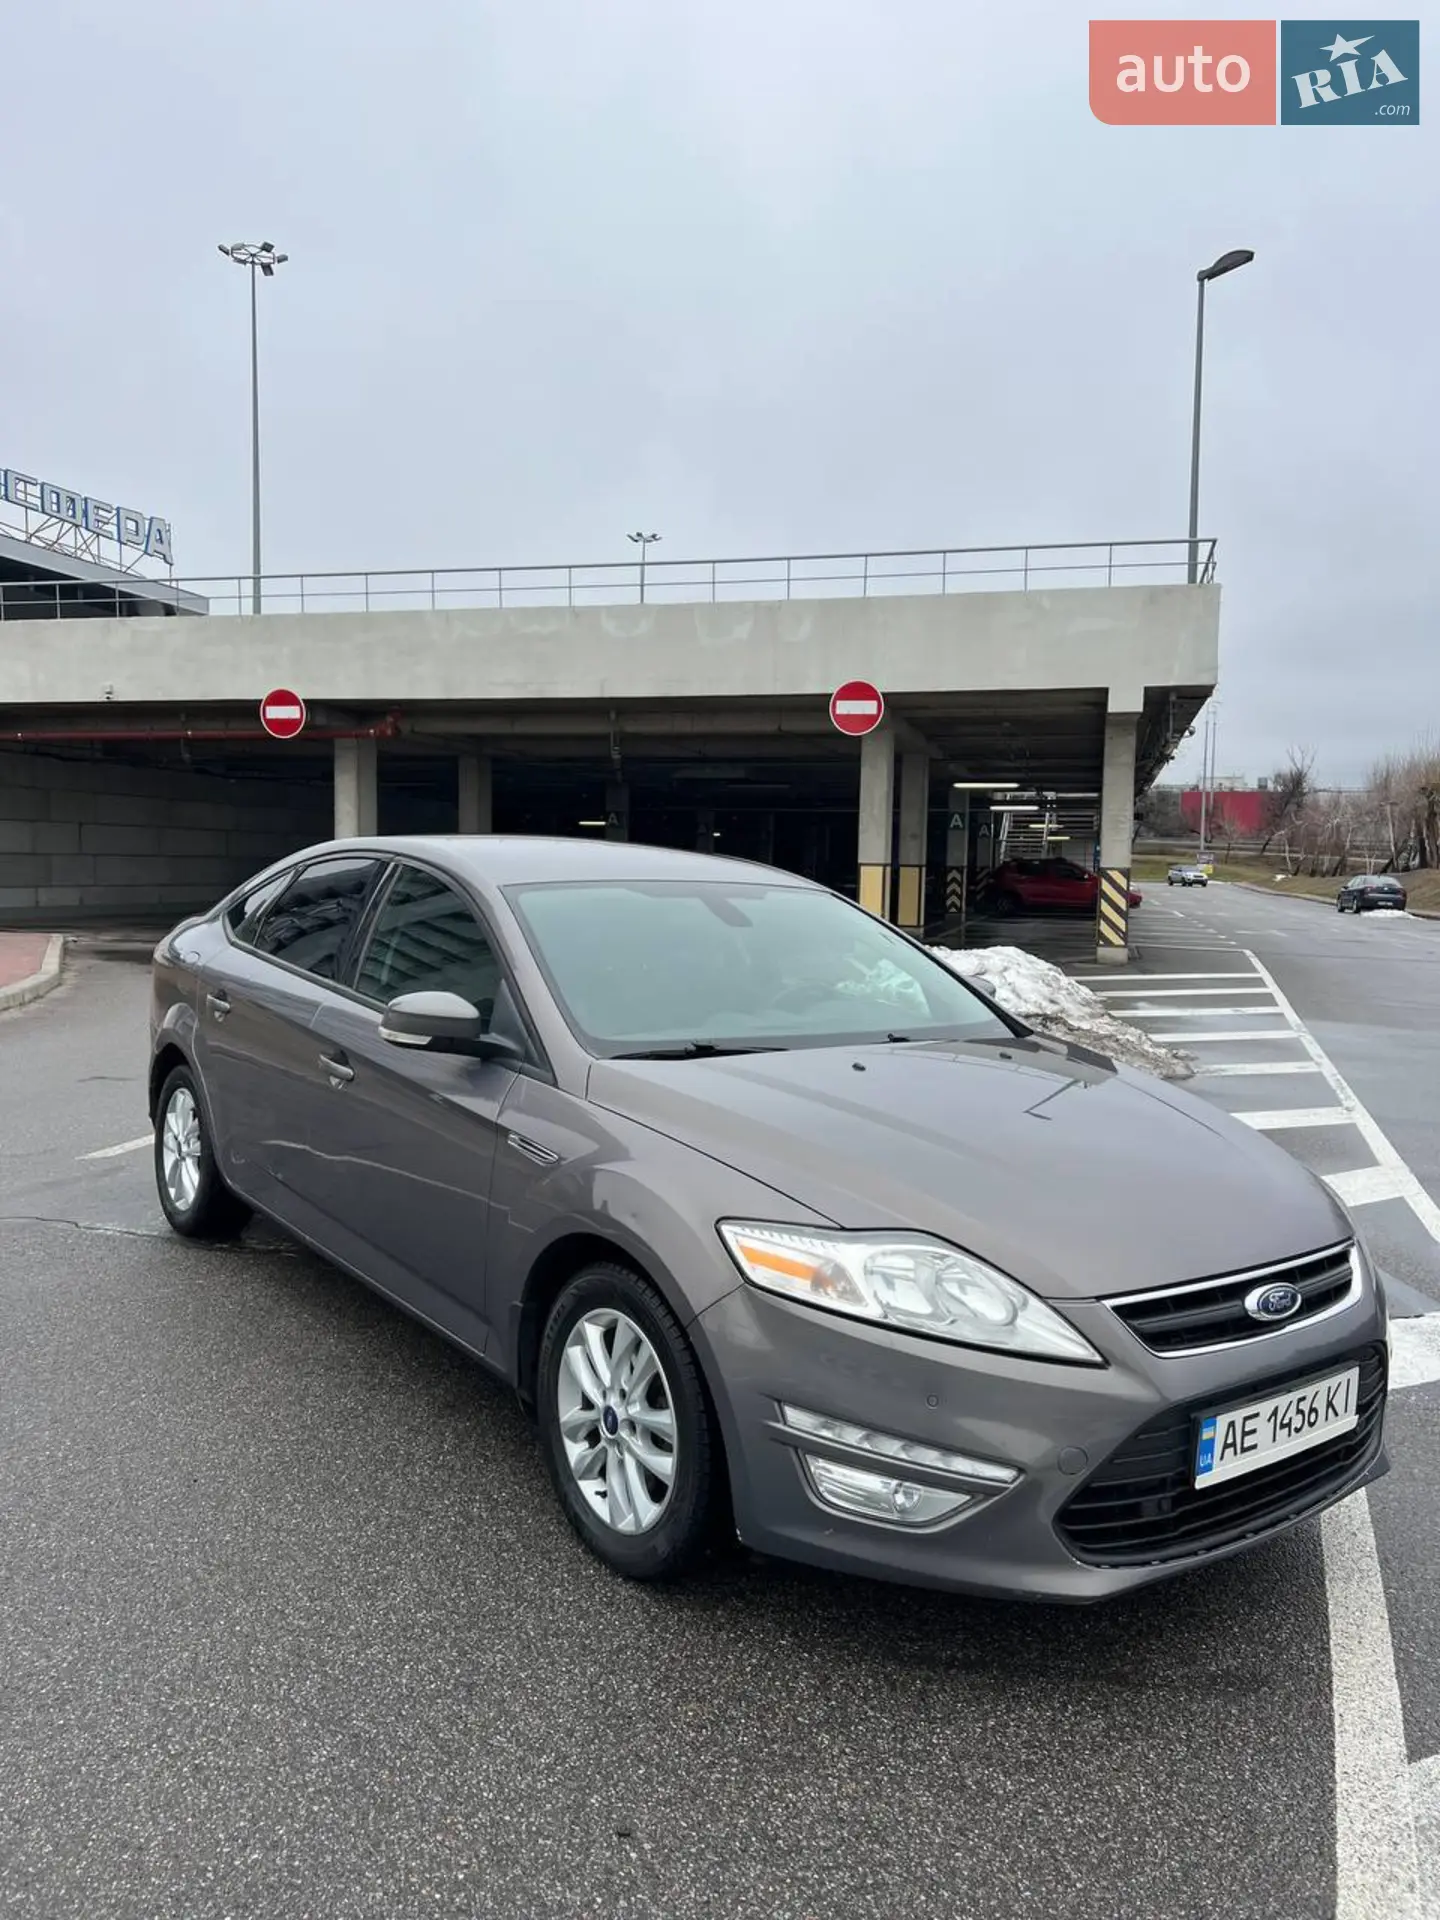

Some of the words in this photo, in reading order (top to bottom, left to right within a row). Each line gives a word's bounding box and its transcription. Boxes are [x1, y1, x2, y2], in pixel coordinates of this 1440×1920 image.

[0, 467, 175, 566] СФЕРА
[950, 813, 964, 829] A
[1219, 1411, 1260, 1461] AE
[1266, 1390, 1321, 1443] 1456
[1325, 1377, 1351, 1421] KI
[1199, 1455, 1213, 1468] UA
